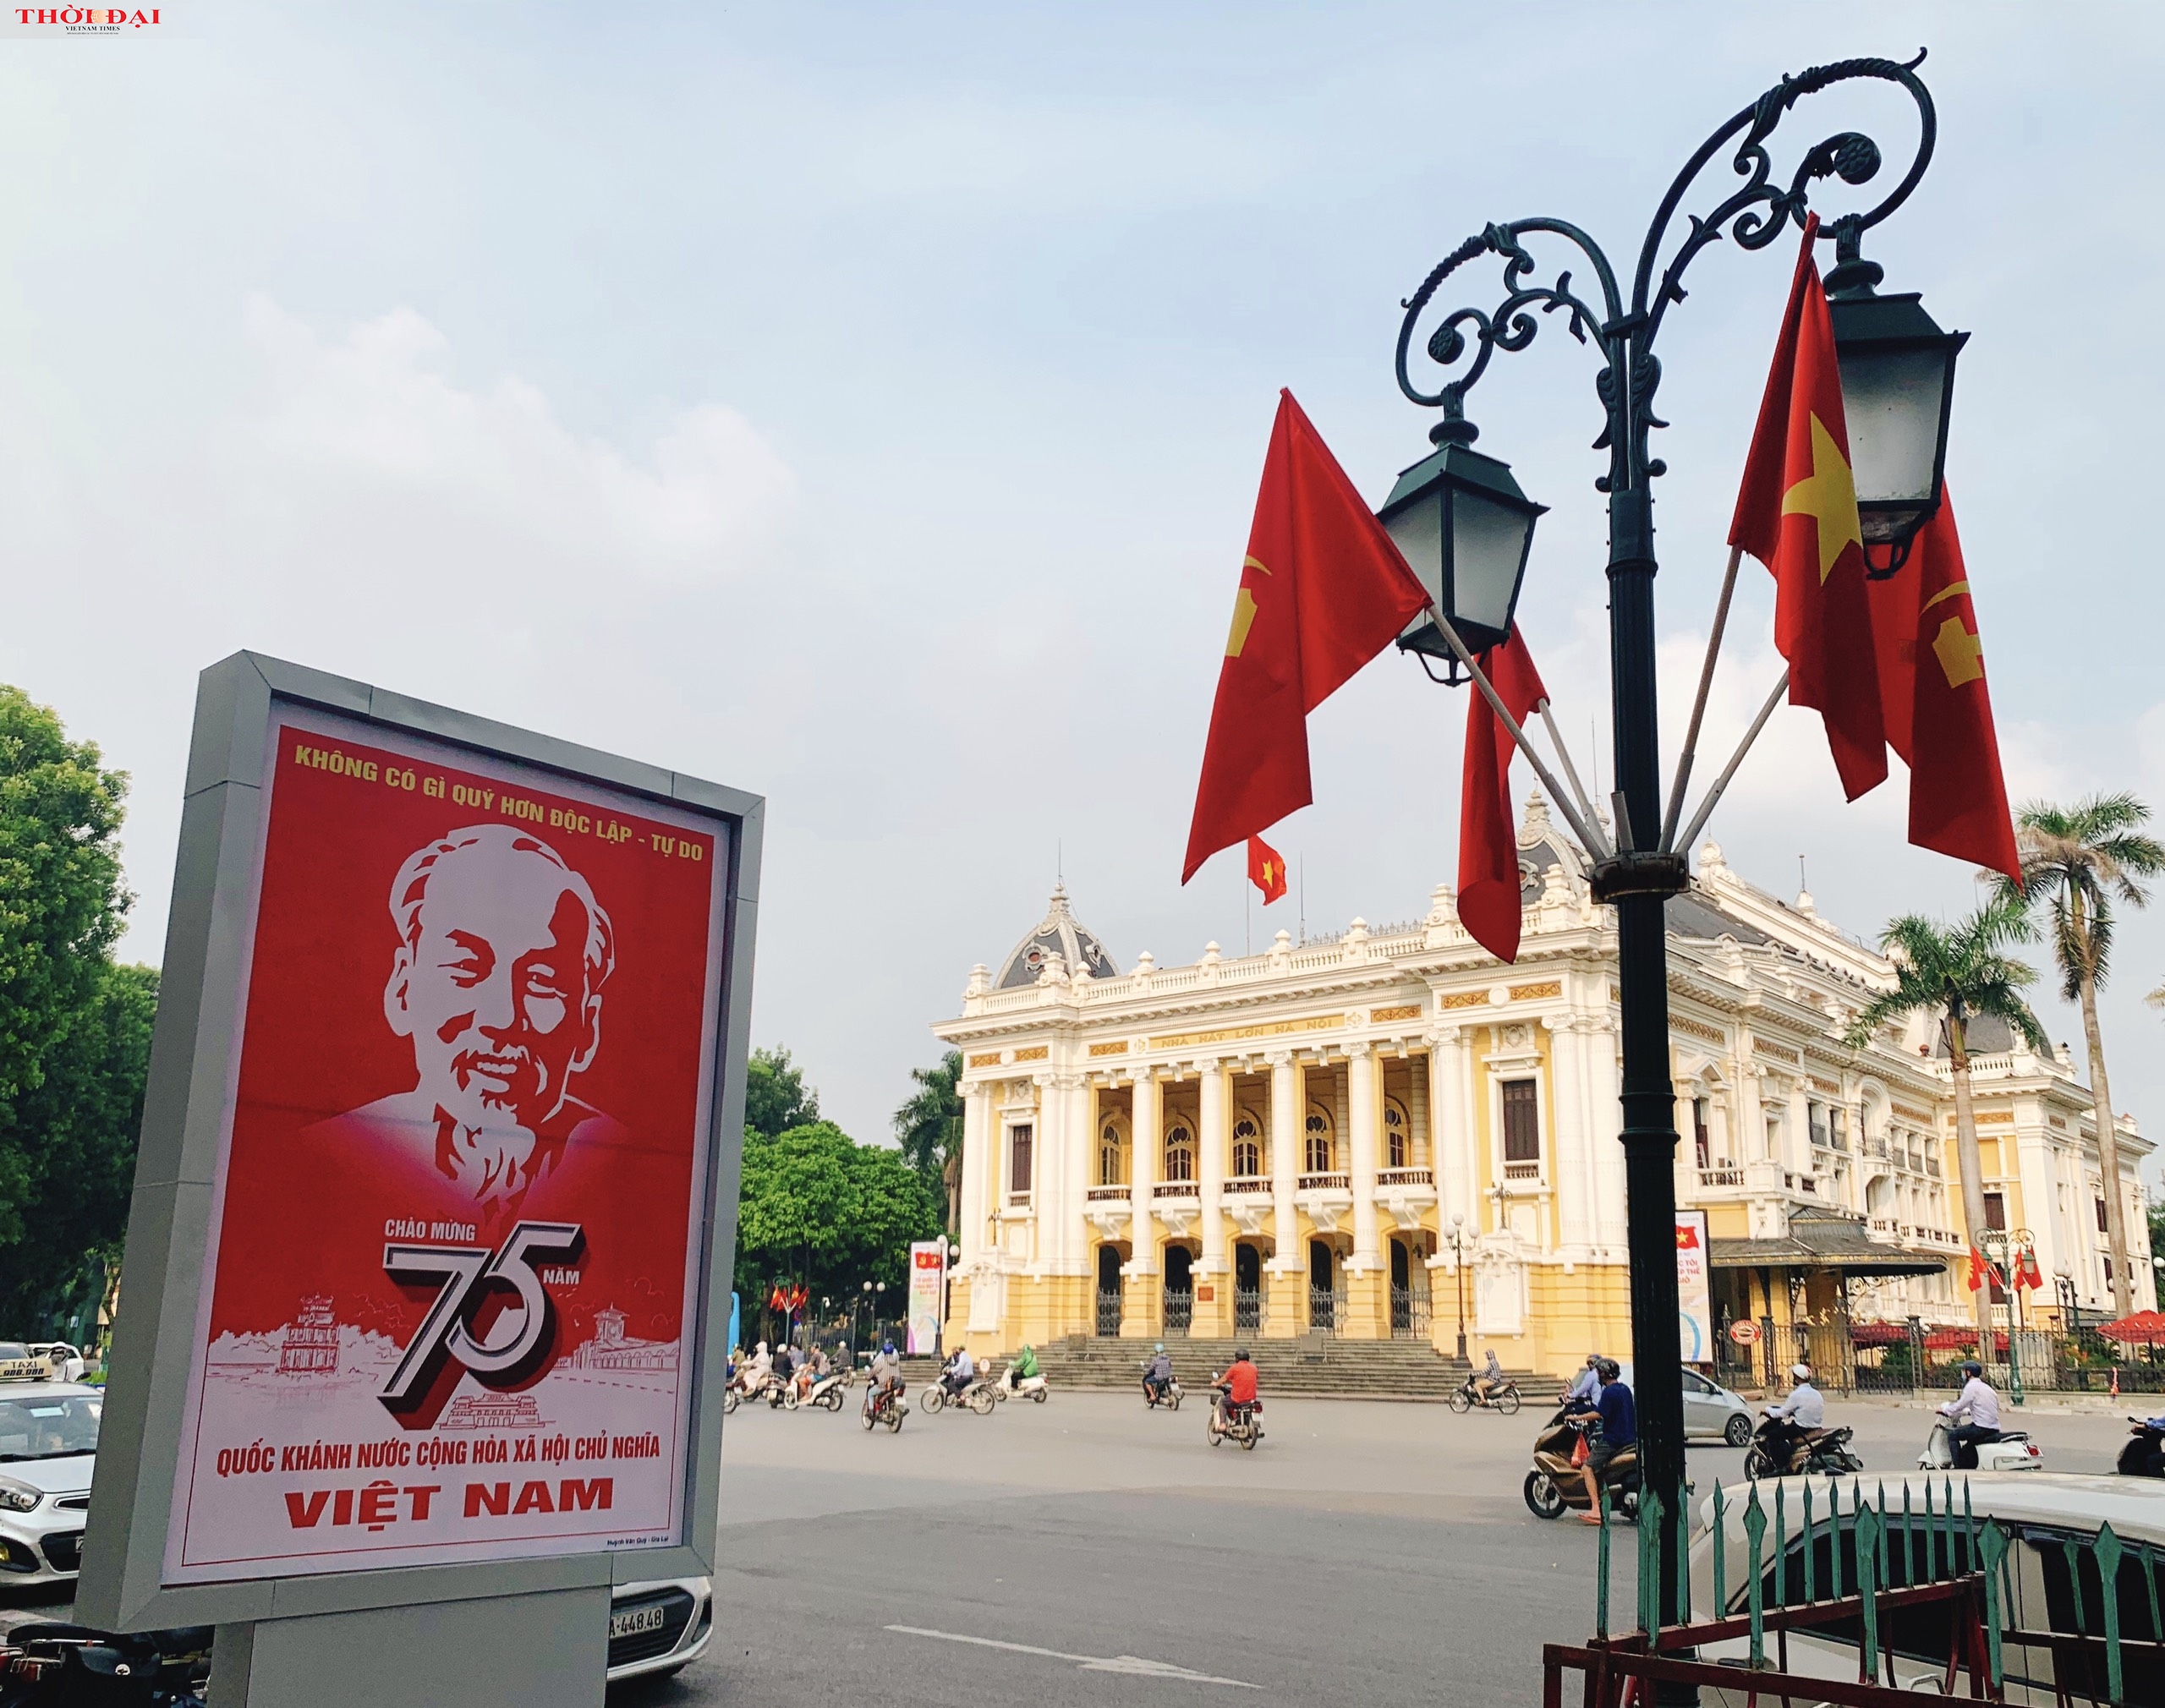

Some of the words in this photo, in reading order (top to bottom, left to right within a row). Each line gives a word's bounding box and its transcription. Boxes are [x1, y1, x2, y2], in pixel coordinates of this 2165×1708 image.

[295, 745, 378, 781] KHÔNG
[386, 768, 415, 791] CÓ
[424, 776, 445, 798] GÌ
[452, 784, 494, 809] QUÝ
[501, 796, 544, 823] HƠN
[550, 809, 590, 834] ĐỘC
[596, 820, 633, 844] LẬP
[651, 834, 675, 857] TỰ
[678, 841, 703, 861] DO
[384, 1218, 426, 1239] CHÀO
[430, 1218, 476, 1241] MỪNG
[543, 1267, 580, 1284] NĂM
[381, 1219, 582, 1398] 75
[216, 1438, 275, 1478] QUỐC
[281, 1440, 352, 1471] KHÁNH
[357, 1437, 411, 1468] NƯỚC
[417, 1437, 467, 1470] CỘNG
[473, 1434, 507, 1464] HÒA
[513, 1434, 536, 1462] XÃ
[541, 1433, 570, 1466] HỘI
[575, 1429, 607, 1460] CHỦ
[612, 1432, 660, 1459] NGHĨA
[285, 1480, 441, 1531] VIỆT
[463, 1478, 614, 1518] NAM
